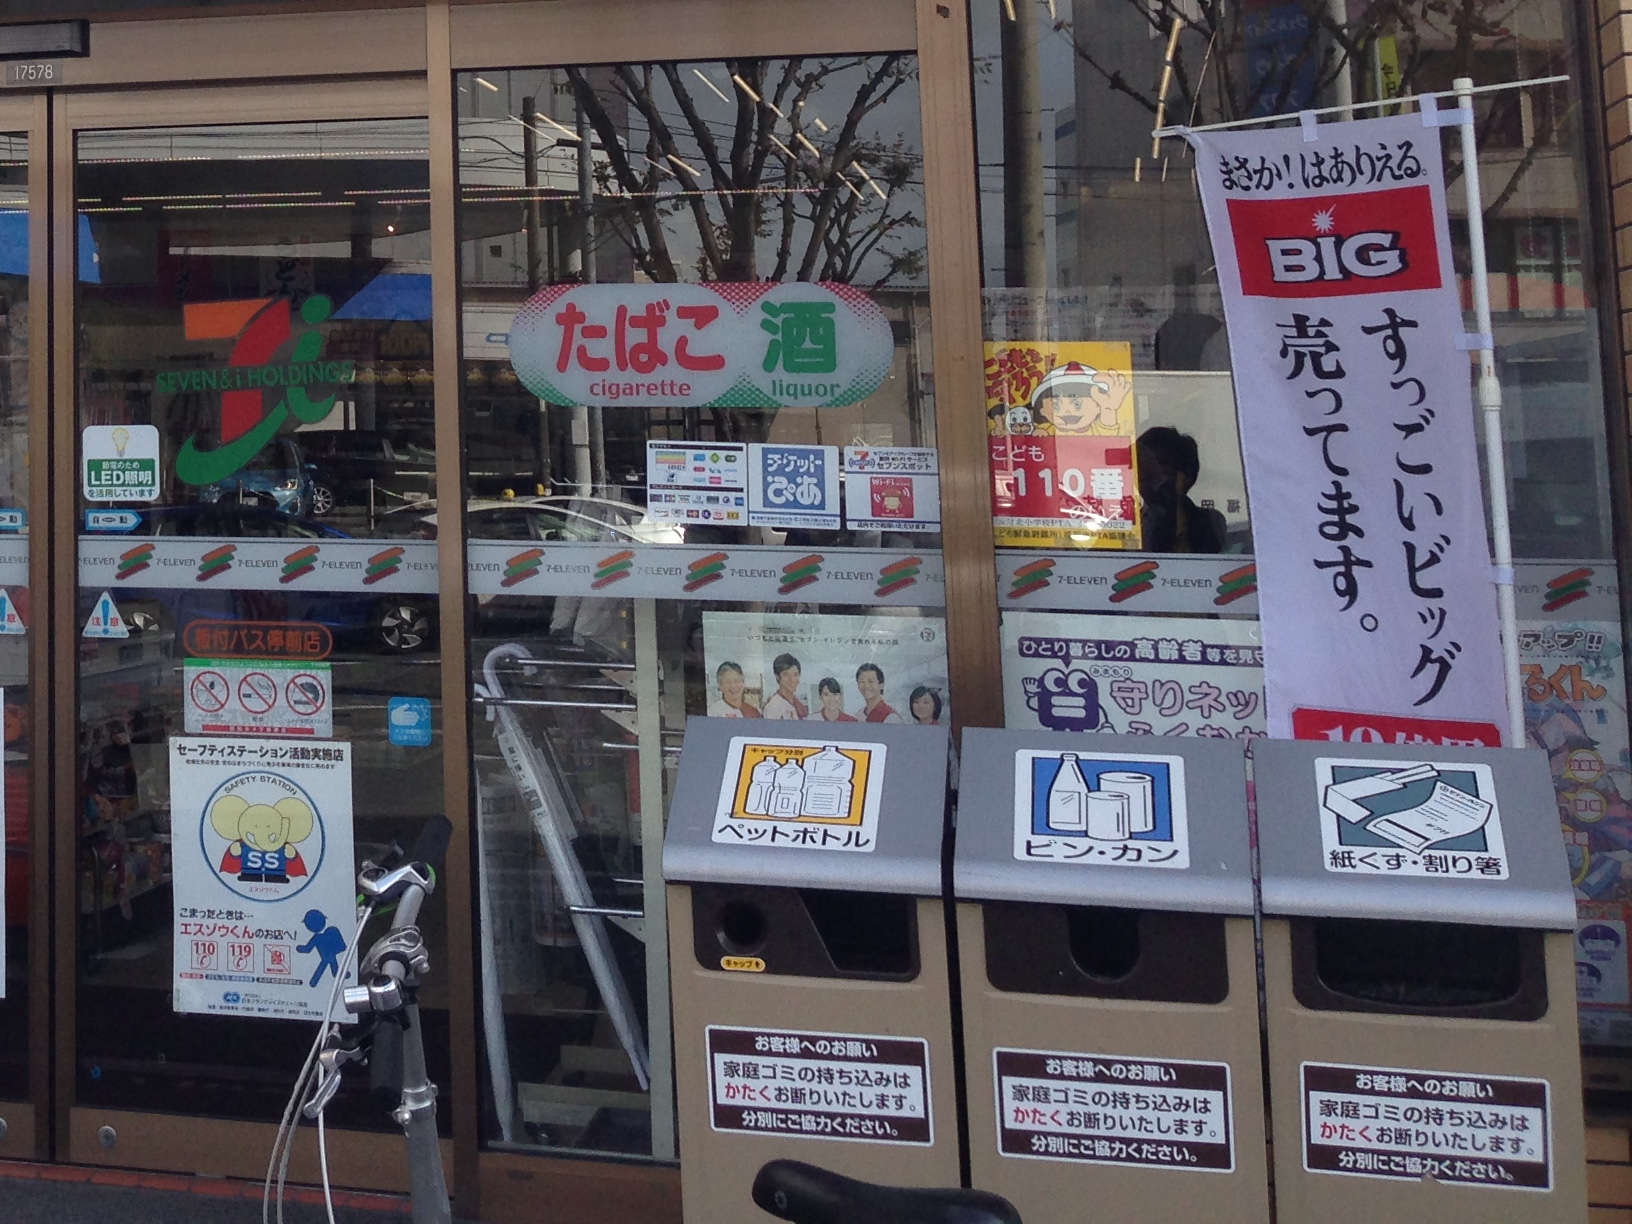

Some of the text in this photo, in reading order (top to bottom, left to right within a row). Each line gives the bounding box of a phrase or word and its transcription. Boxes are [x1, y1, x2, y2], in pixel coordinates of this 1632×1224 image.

[14, 64, 54, 80] 17578
[1265, 229, 1410, 284] BIG
[555, 298, 726, 374] たばこ
[760, 300, 837, 374] 酒
[589, 378, 691, 399] cigarette
[772, 378, 841, 399] liquor
[992, 444, 1045, 462] こども
[90, 470, 152, 485] LED照明
[1275, 313, 1380, 633] 売ってます。
[1361, 307, 1464, 708] すっごいビッグ
[177, 743, 345, 762] セーフティステーション活動実施店
[224, 775, 298, 796] SAFETY STATION
[718, 823, 871, 849] ペットボトル
[247, 851, 280, 869] SS
[1026, 839, 1179, 863] ビン・カン
[1329, 849, 1503, 876] 紙くず・割り箸
[193, 942, 215, 956] 110
[229, 944, 252, 957] 119
[755, 1035, 878, 1058] お客様へのお願い
[723, 1061, 911, 1089] 家庭ゴミの持ち込みは
[1045, 1059, 1177, 1081] お客様へのお願い
[724, 1082, 917, 1112] かたくお断りいたします。
[1355, 1073, 1494, 1098] お客様へのお願い
[1011, 1084, 1212, 1114] 家庭ゴミの持ち込みは
[741, 1110, 899, 1136] 分別にご協力ください。
[1013, 1107, 1217, 1138] かたくお断りいたします。
[1319, 1099, 1530, 1132] 家庭ゴミの持ち込みは
[1031, 1134, 1198, 1163] 分別にご協力ください。
[1320, 1122, 1535, 1156] かたくお断りいたします。
[1338, 1150, 1514, 1182] 分別にご協力ください。
